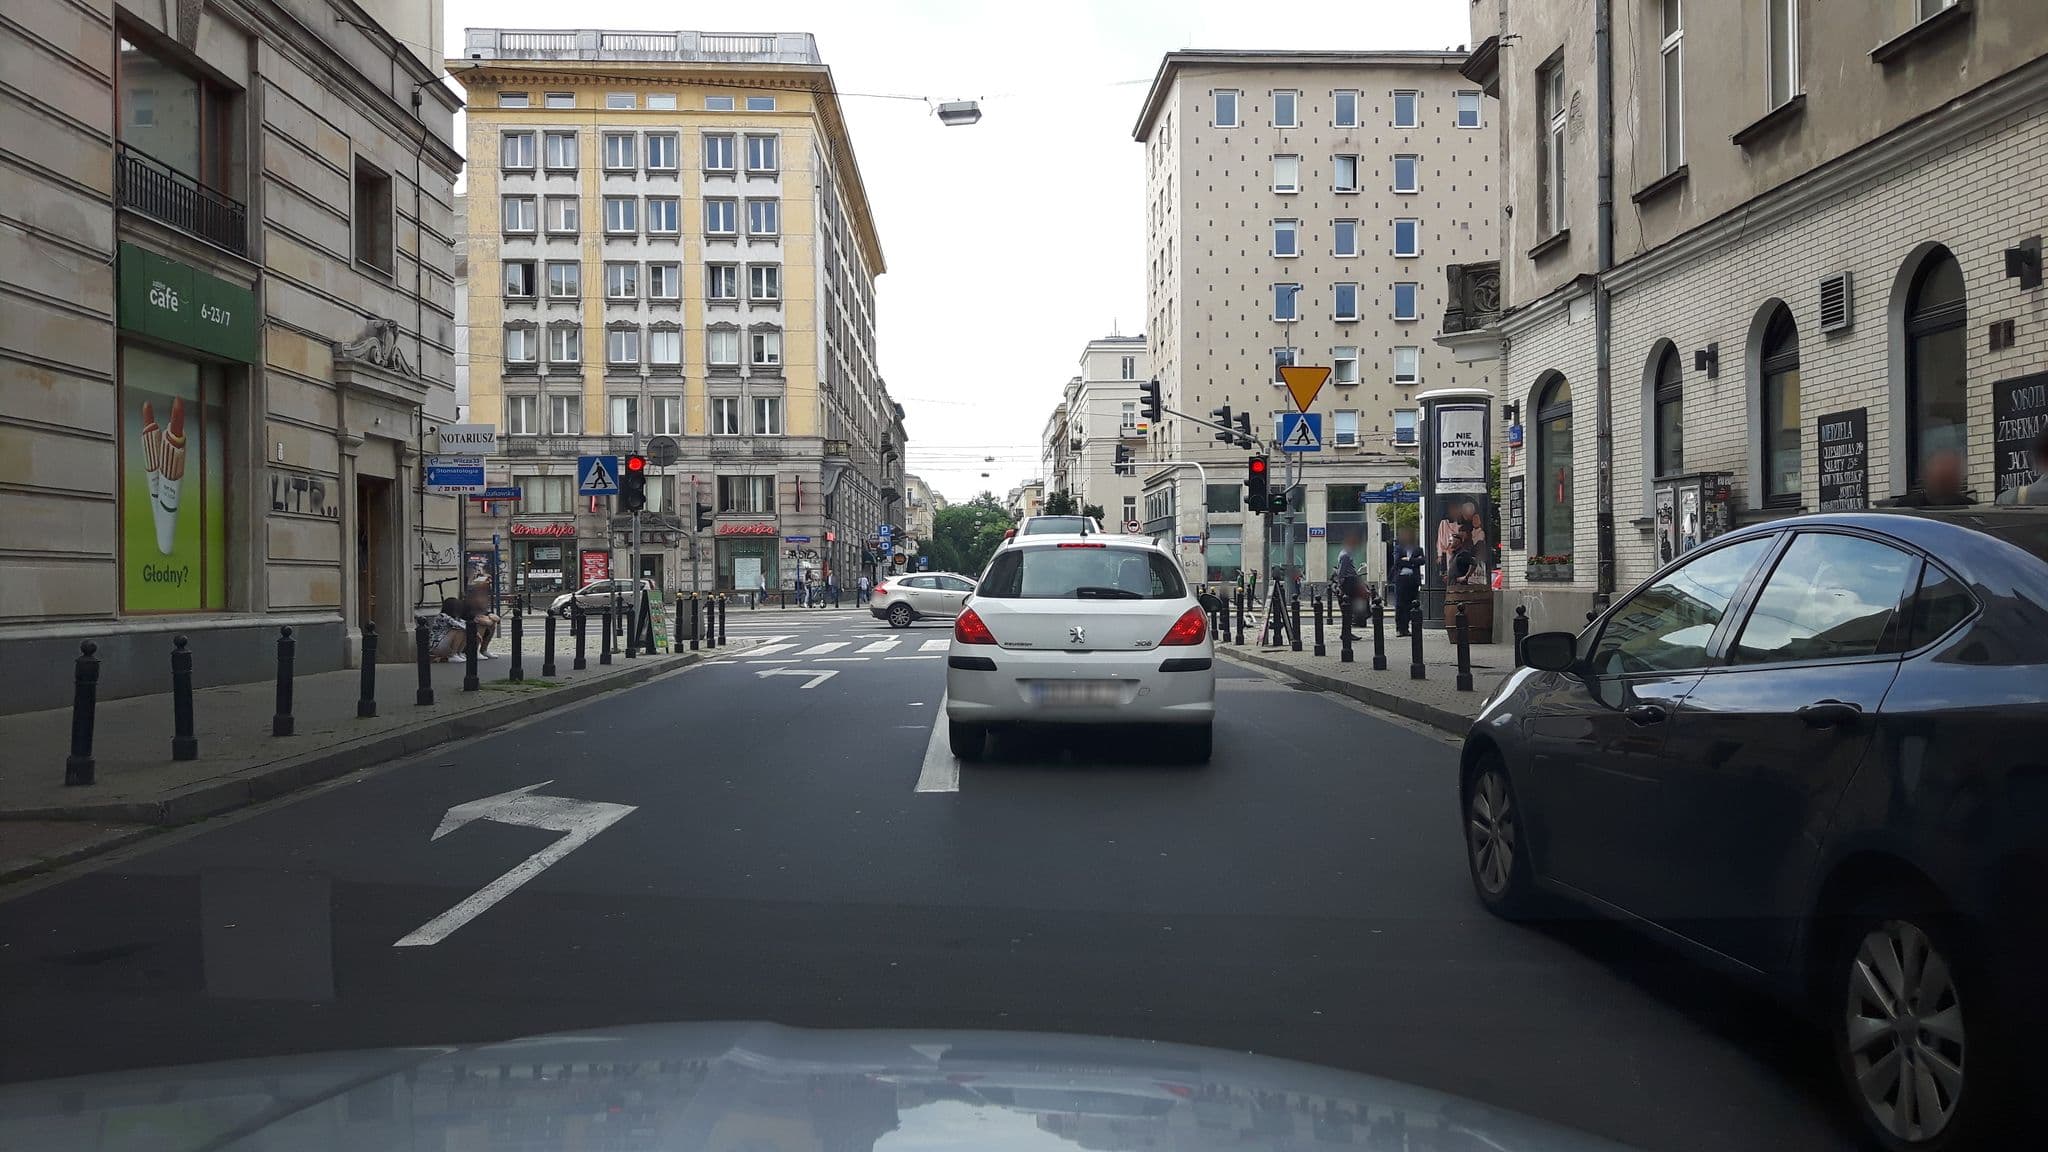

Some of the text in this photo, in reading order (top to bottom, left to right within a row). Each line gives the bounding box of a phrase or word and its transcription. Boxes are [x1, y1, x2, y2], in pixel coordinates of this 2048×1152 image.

[201, 304, 231, 326] 6-23/7
[2011, 385, 2046, 412] SOBOTA
[441, 433, 494, 444] NOTARIUSZ
[143, 564, 189, 588] Głodny?
